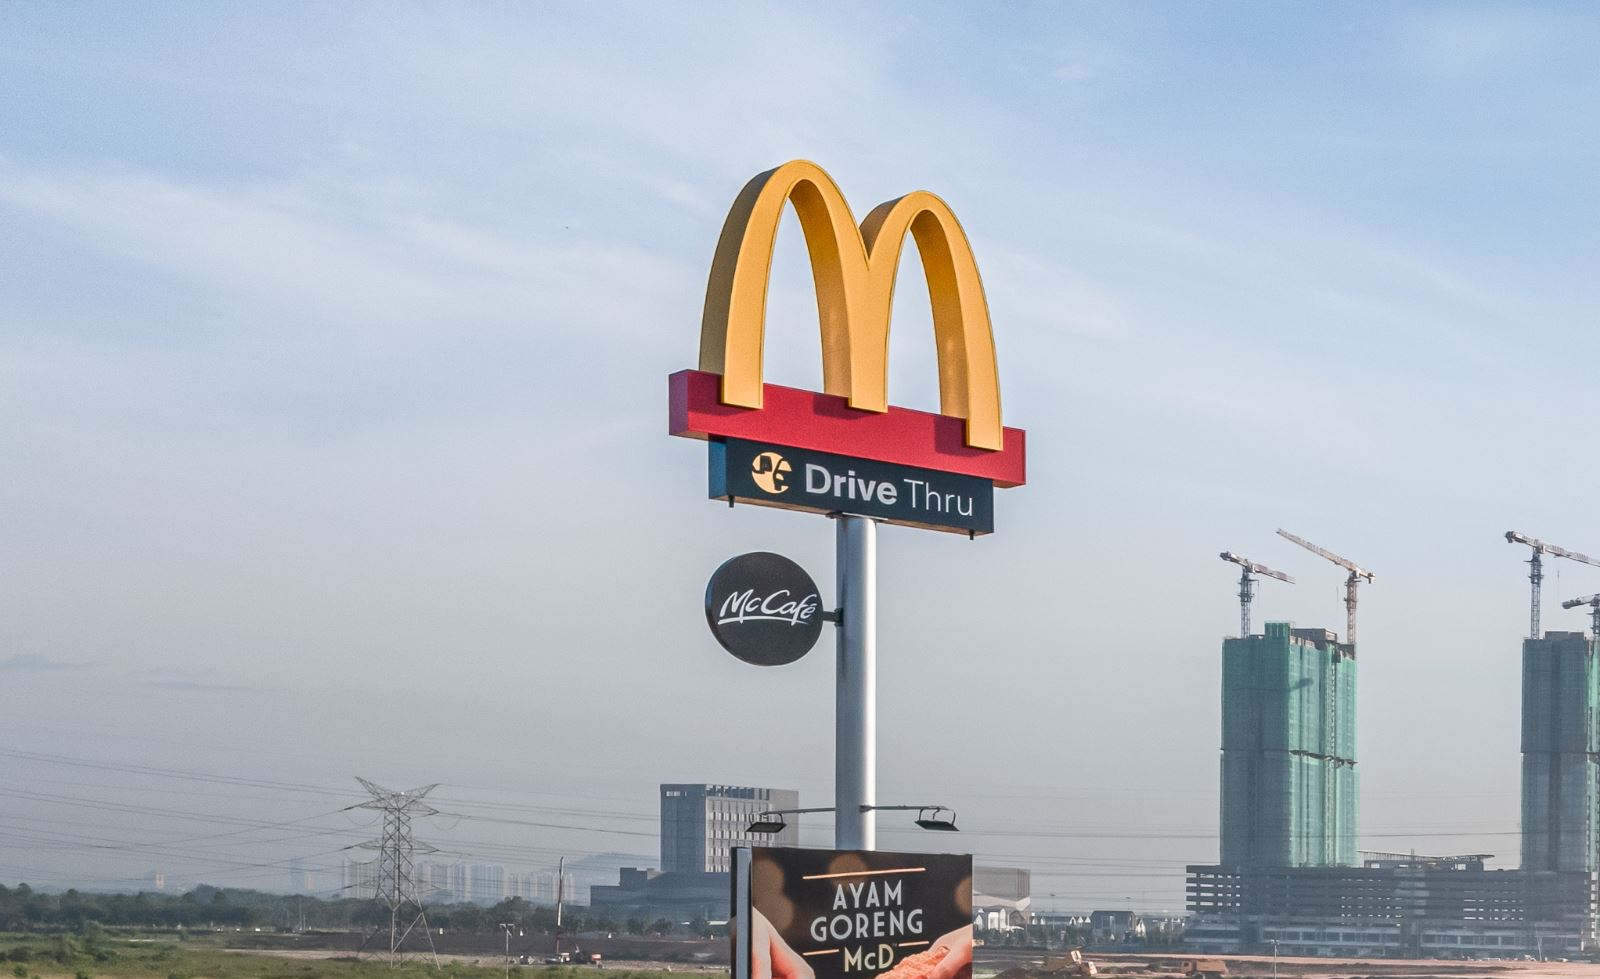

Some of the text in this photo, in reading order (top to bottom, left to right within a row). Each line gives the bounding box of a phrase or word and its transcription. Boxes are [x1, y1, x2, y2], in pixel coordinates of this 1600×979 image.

[805, 463, 974, 517] Drive Thru
[718, 589, 818, 625] McCafé
[832, 879, 902, 911] AYAM
[810, 908, 923, 942] GORENG
[844, 943, 895, 973] McD
